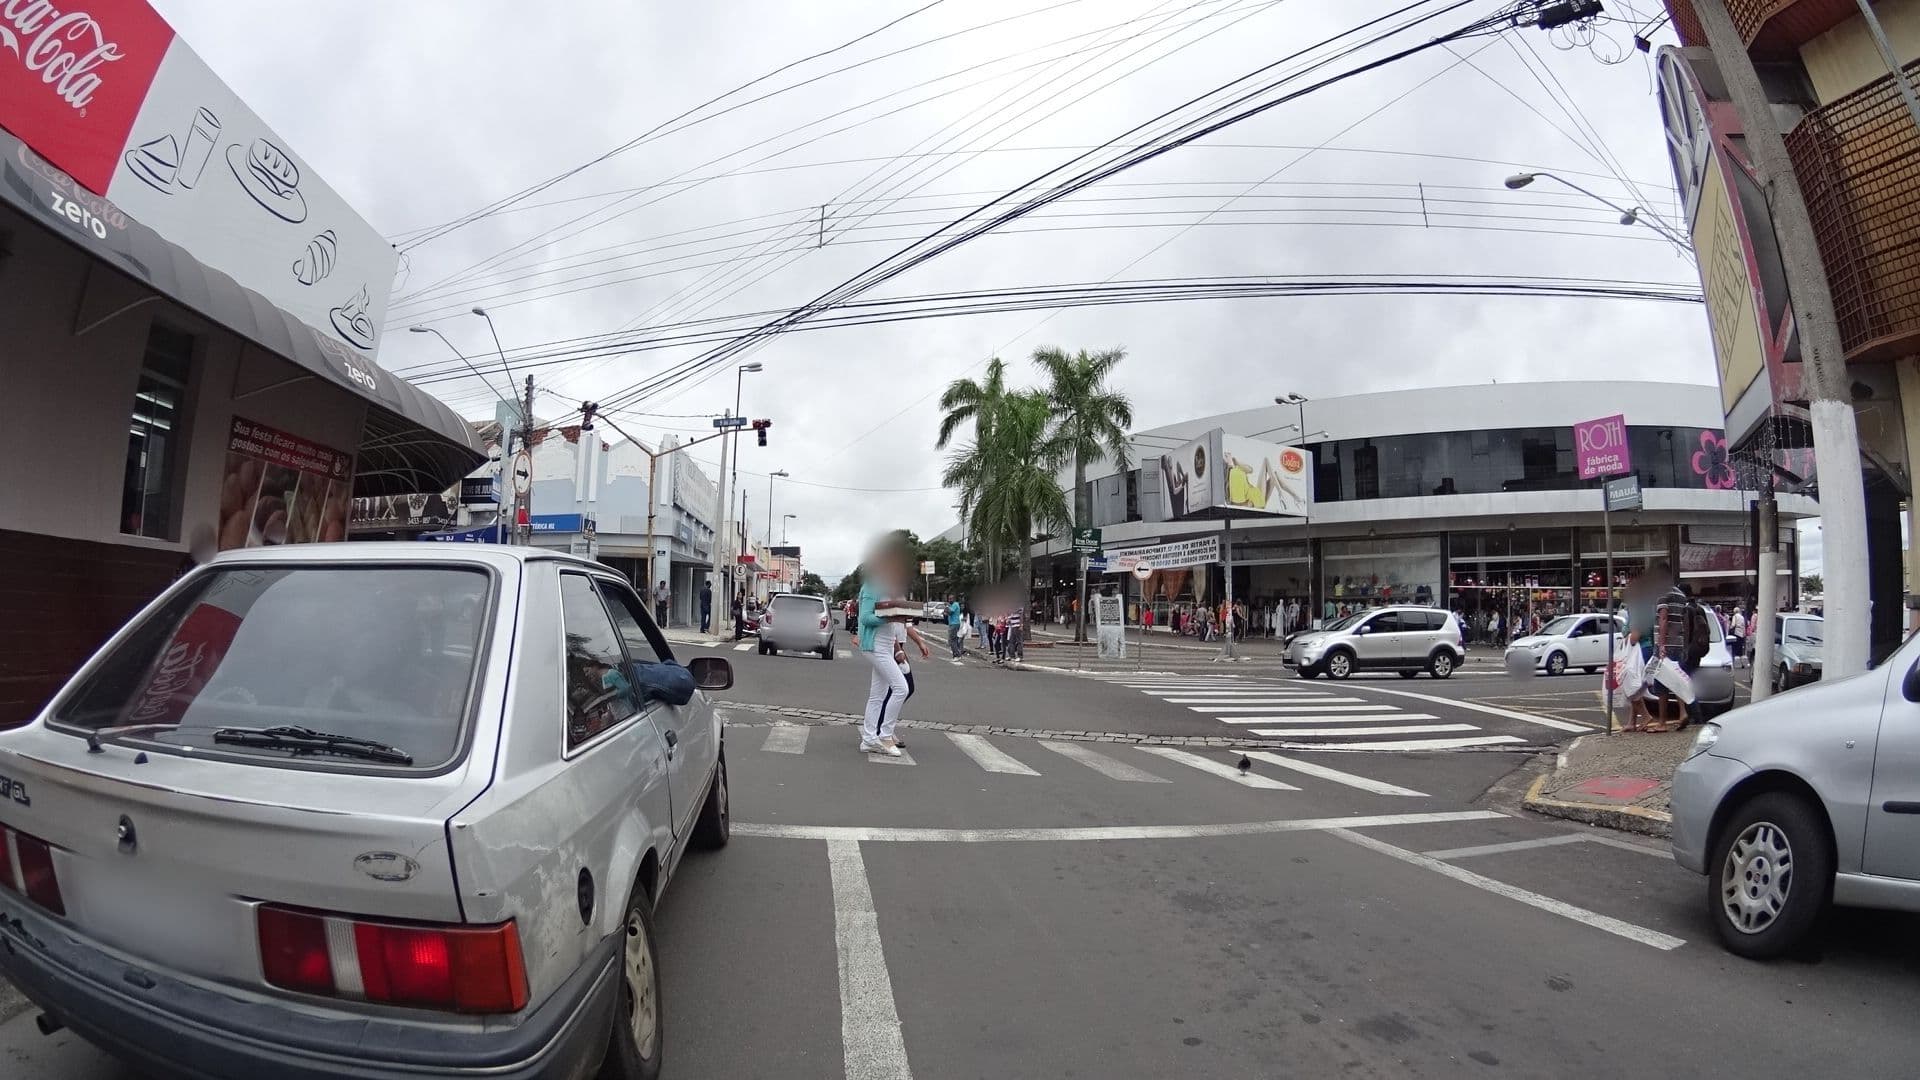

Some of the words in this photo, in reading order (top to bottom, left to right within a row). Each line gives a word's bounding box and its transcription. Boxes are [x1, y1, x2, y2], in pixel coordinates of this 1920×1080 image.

[51, 191, 107, 239] zero
[343, 361, 377, 391] zero
[233, 421, 250, 436] Sua
[250, 427, 273, 442] festa
[1579, 420, 1622, 453] ROTH
[264, 447, 281, 457] com
[281, 452, 291, 461] os
[1586, 454, 1620, 467] fábrica
[1584, 466, 1596, 476] de
[1598, 461, 1624, 473] moda
[1609, 483, 1638, 499] MAUÁ
